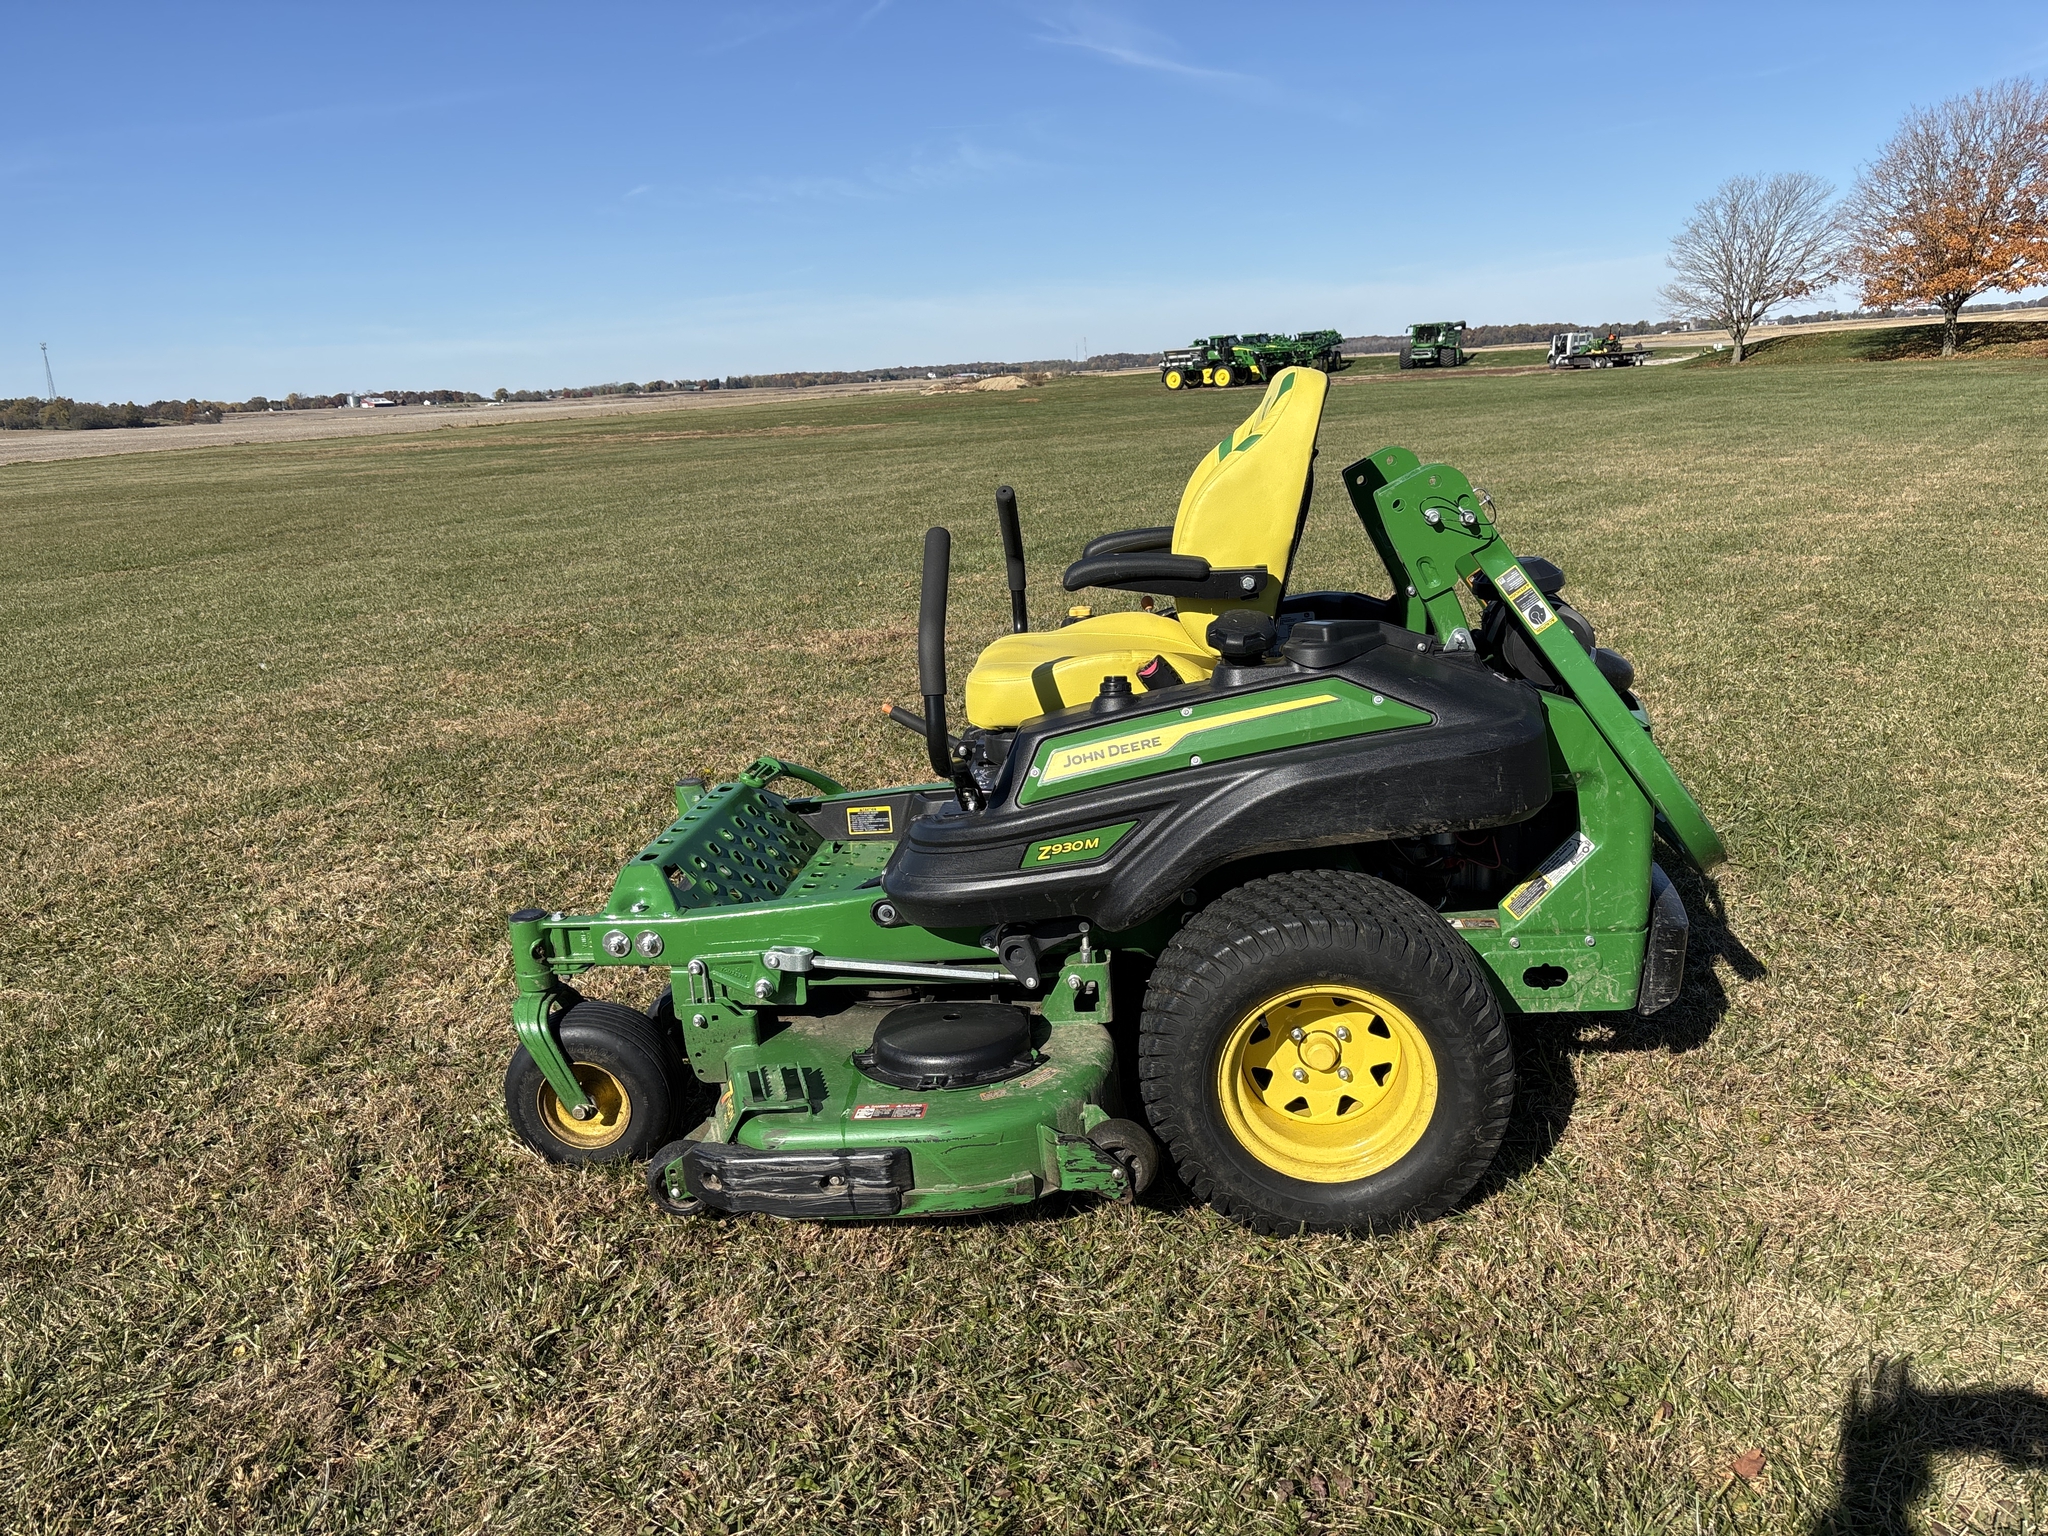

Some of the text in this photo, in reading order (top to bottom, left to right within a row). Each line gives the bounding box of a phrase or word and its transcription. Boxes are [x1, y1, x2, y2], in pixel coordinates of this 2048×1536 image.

[1063, 736, 1162, 768] JOHN DEERE
[1037, 837, 1100, 861] Z930M
